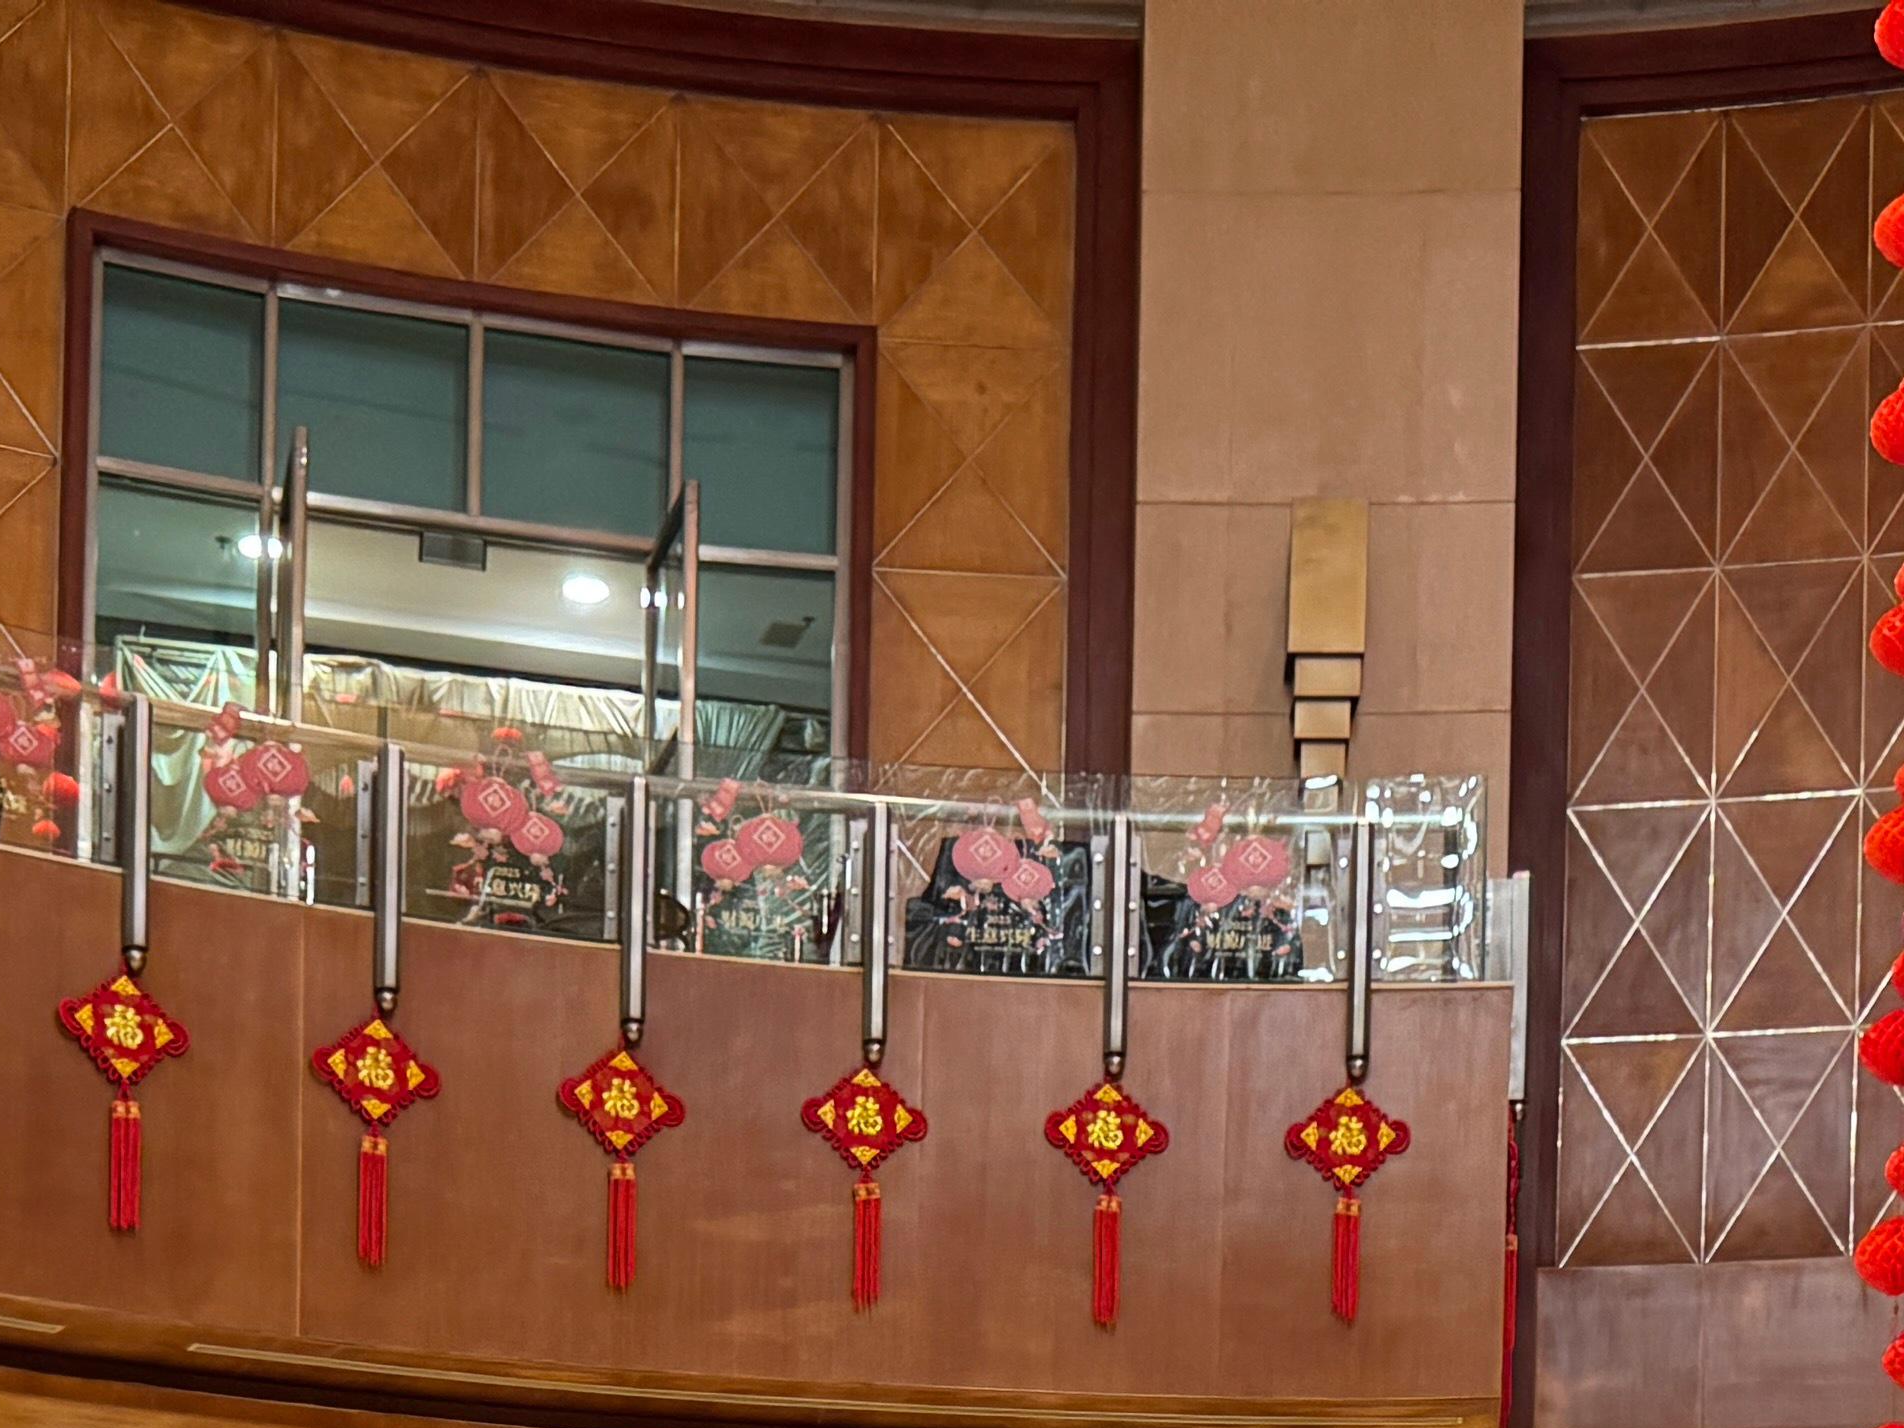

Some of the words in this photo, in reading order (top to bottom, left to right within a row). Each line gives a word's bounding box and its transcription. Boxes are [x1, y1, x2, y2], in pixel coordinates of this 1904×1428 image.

[104, 1004, 144, 1050] 福
[356, 1046, 395, 1090] 福
[602, 1078, 640, 1120] 福
[846, 1096, 883, 1136] 福
[1087, 1110, 1124, 1150] 福
[1329, 1116, 1367, 1155] 福
